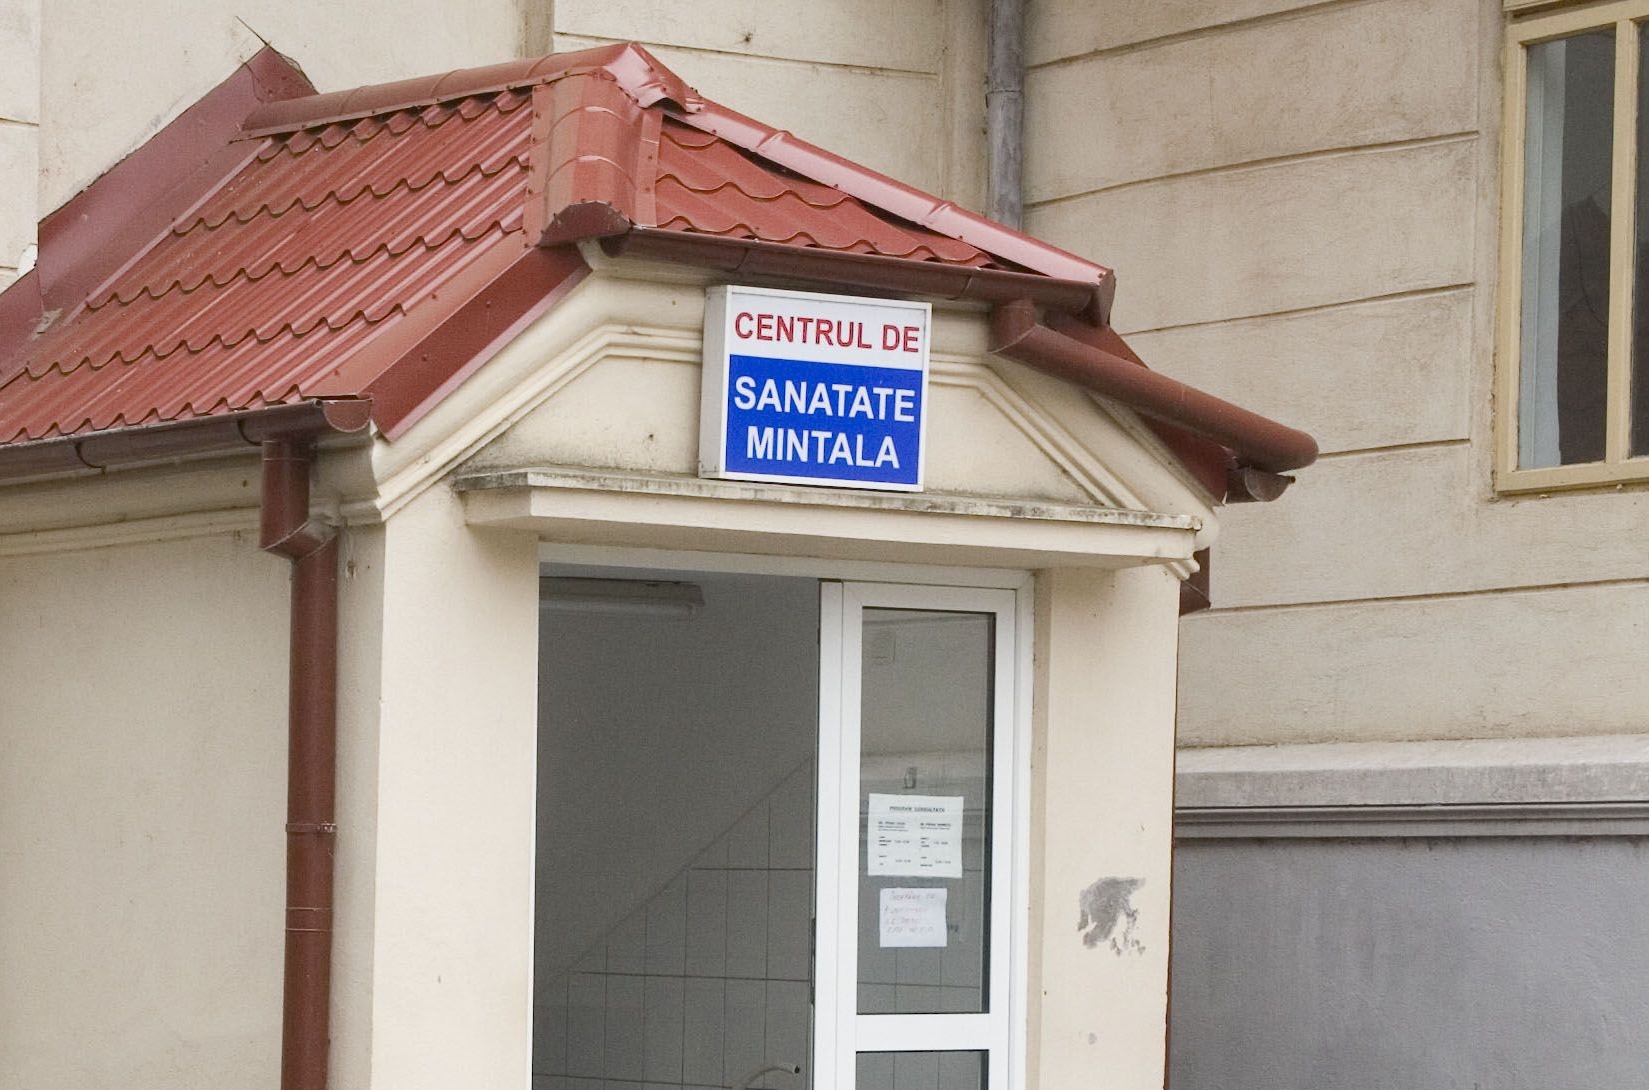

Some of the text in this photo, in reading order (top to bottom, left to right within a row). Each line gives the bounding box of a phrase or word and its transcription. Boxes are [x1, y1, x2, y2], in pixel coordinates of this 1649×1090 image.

[735, 312, 919, 353] CENTRUL DE
[734, 376, 915, 422] SANATATE
[747, 426, 900, 469] MINTALA
